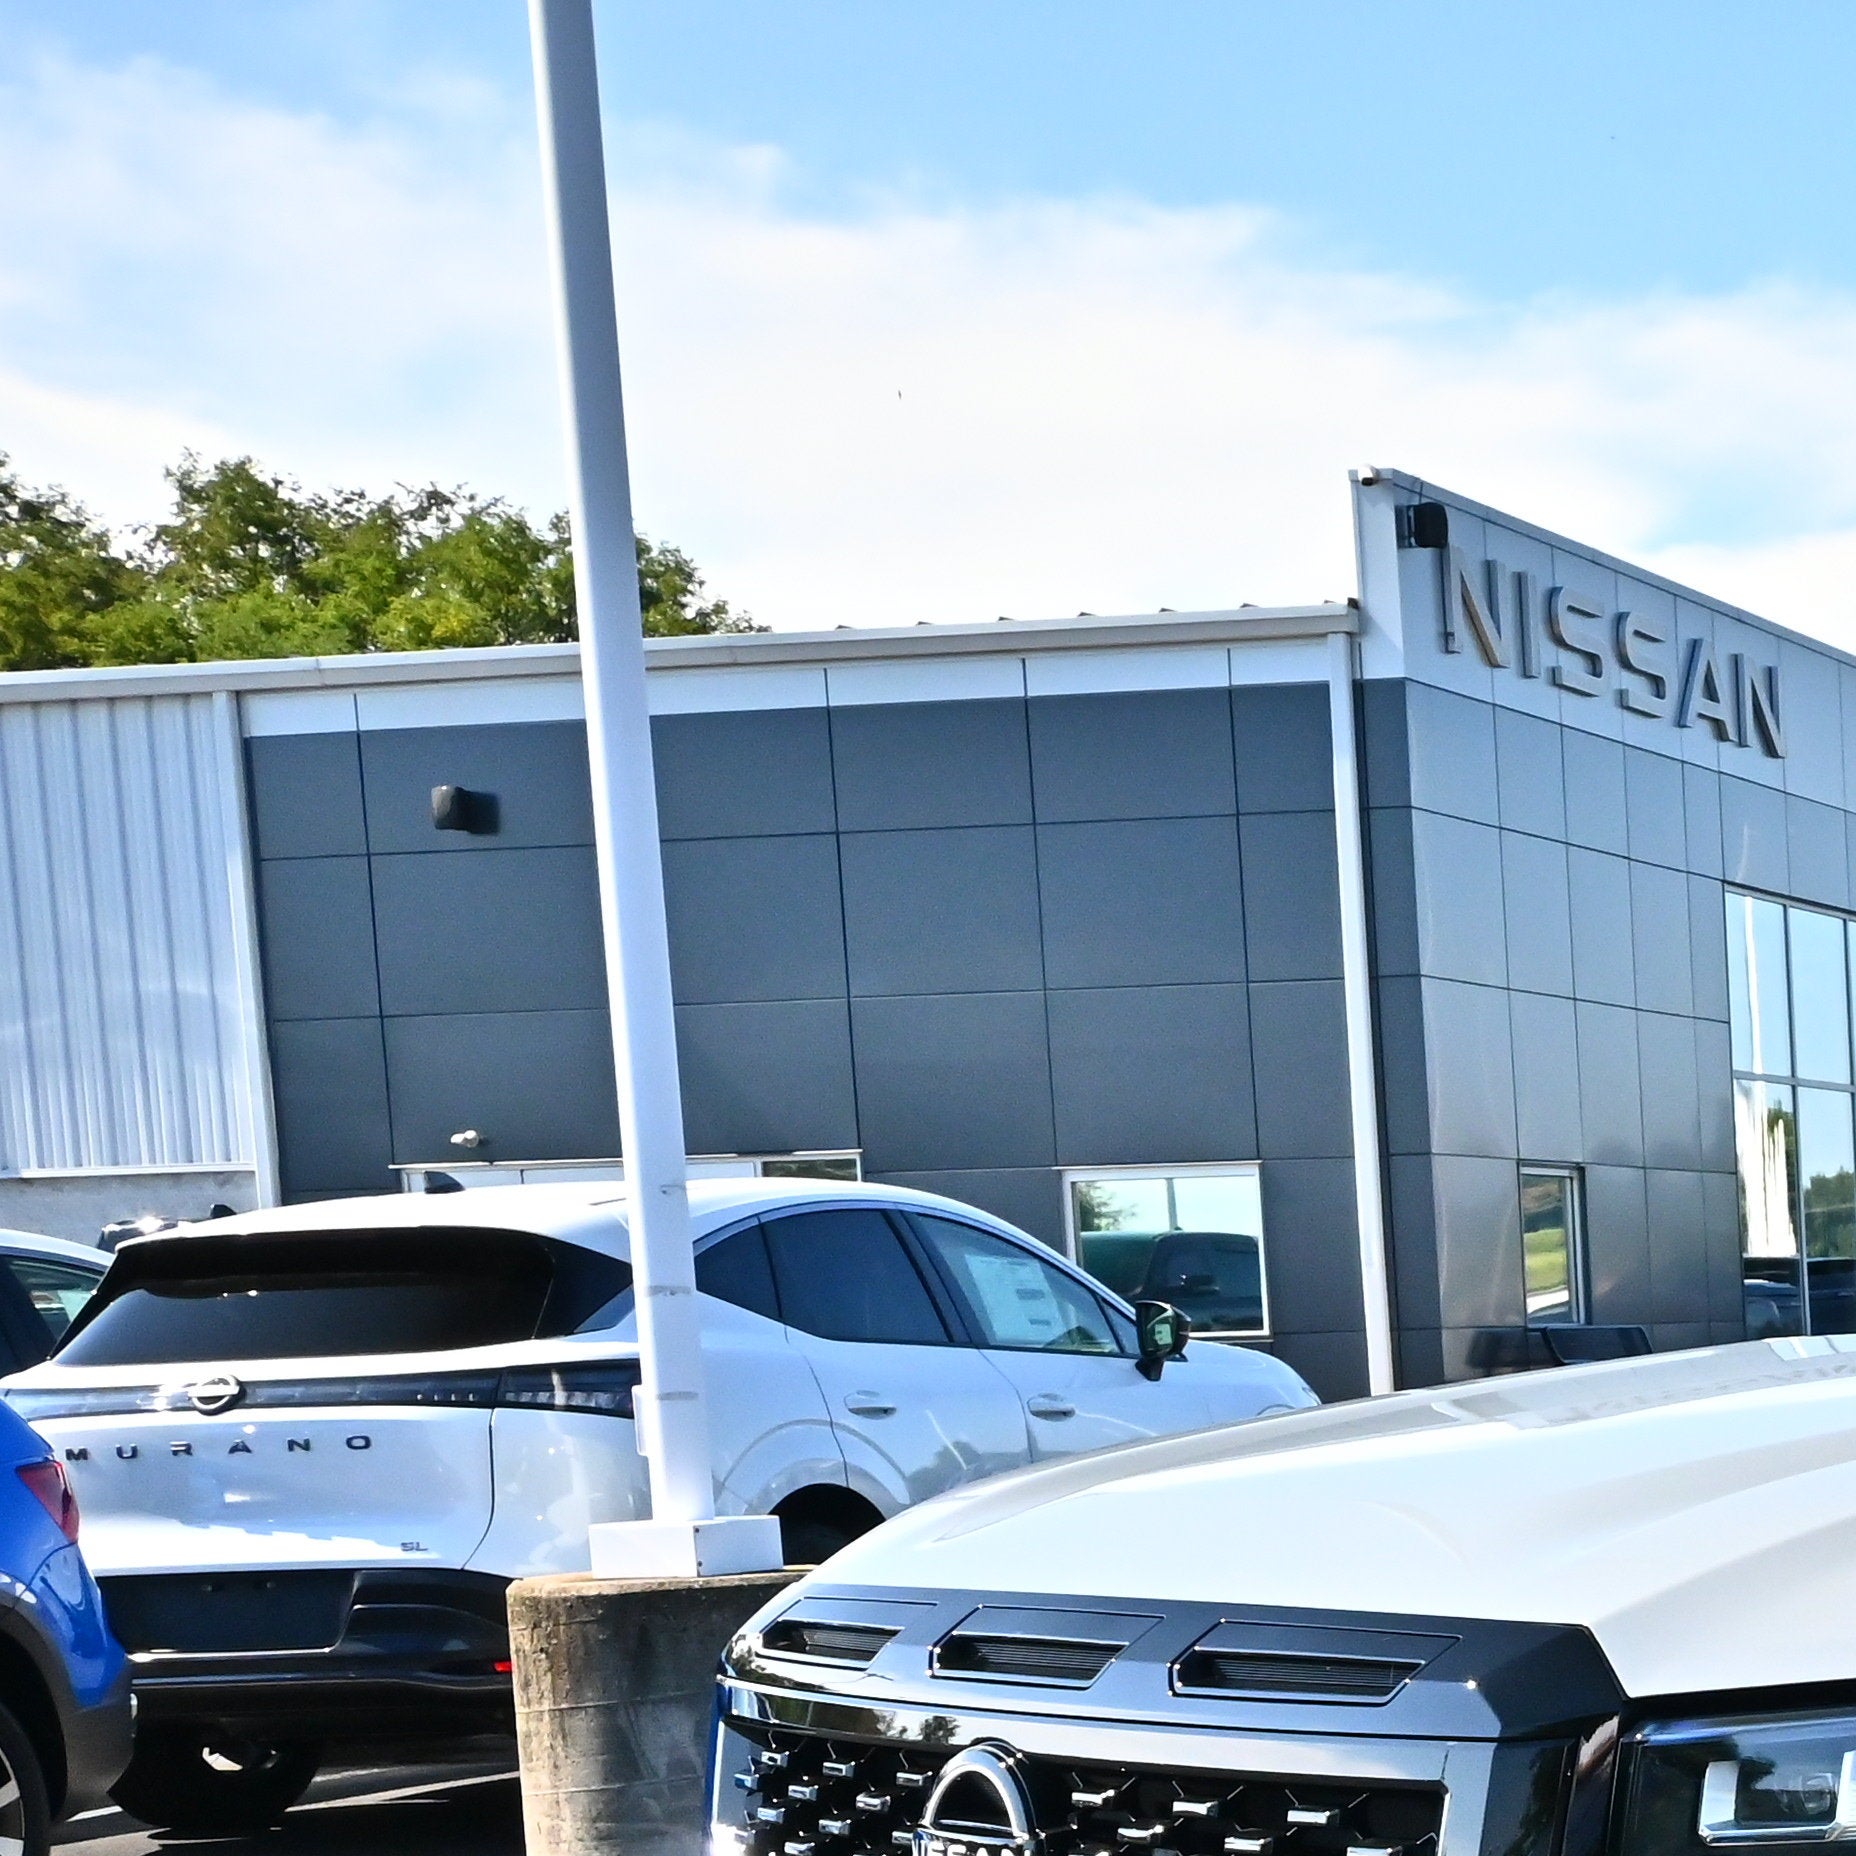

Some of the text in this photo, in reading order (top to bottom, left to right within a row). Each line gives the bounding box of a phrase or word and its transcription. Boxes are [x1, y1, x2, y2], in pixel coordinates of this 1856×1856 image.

[1440, 547, 1785, 759] NISSAN
[65, 1435, 371, 1461] MURANO
[401, 1541, 428, 1552] SL
